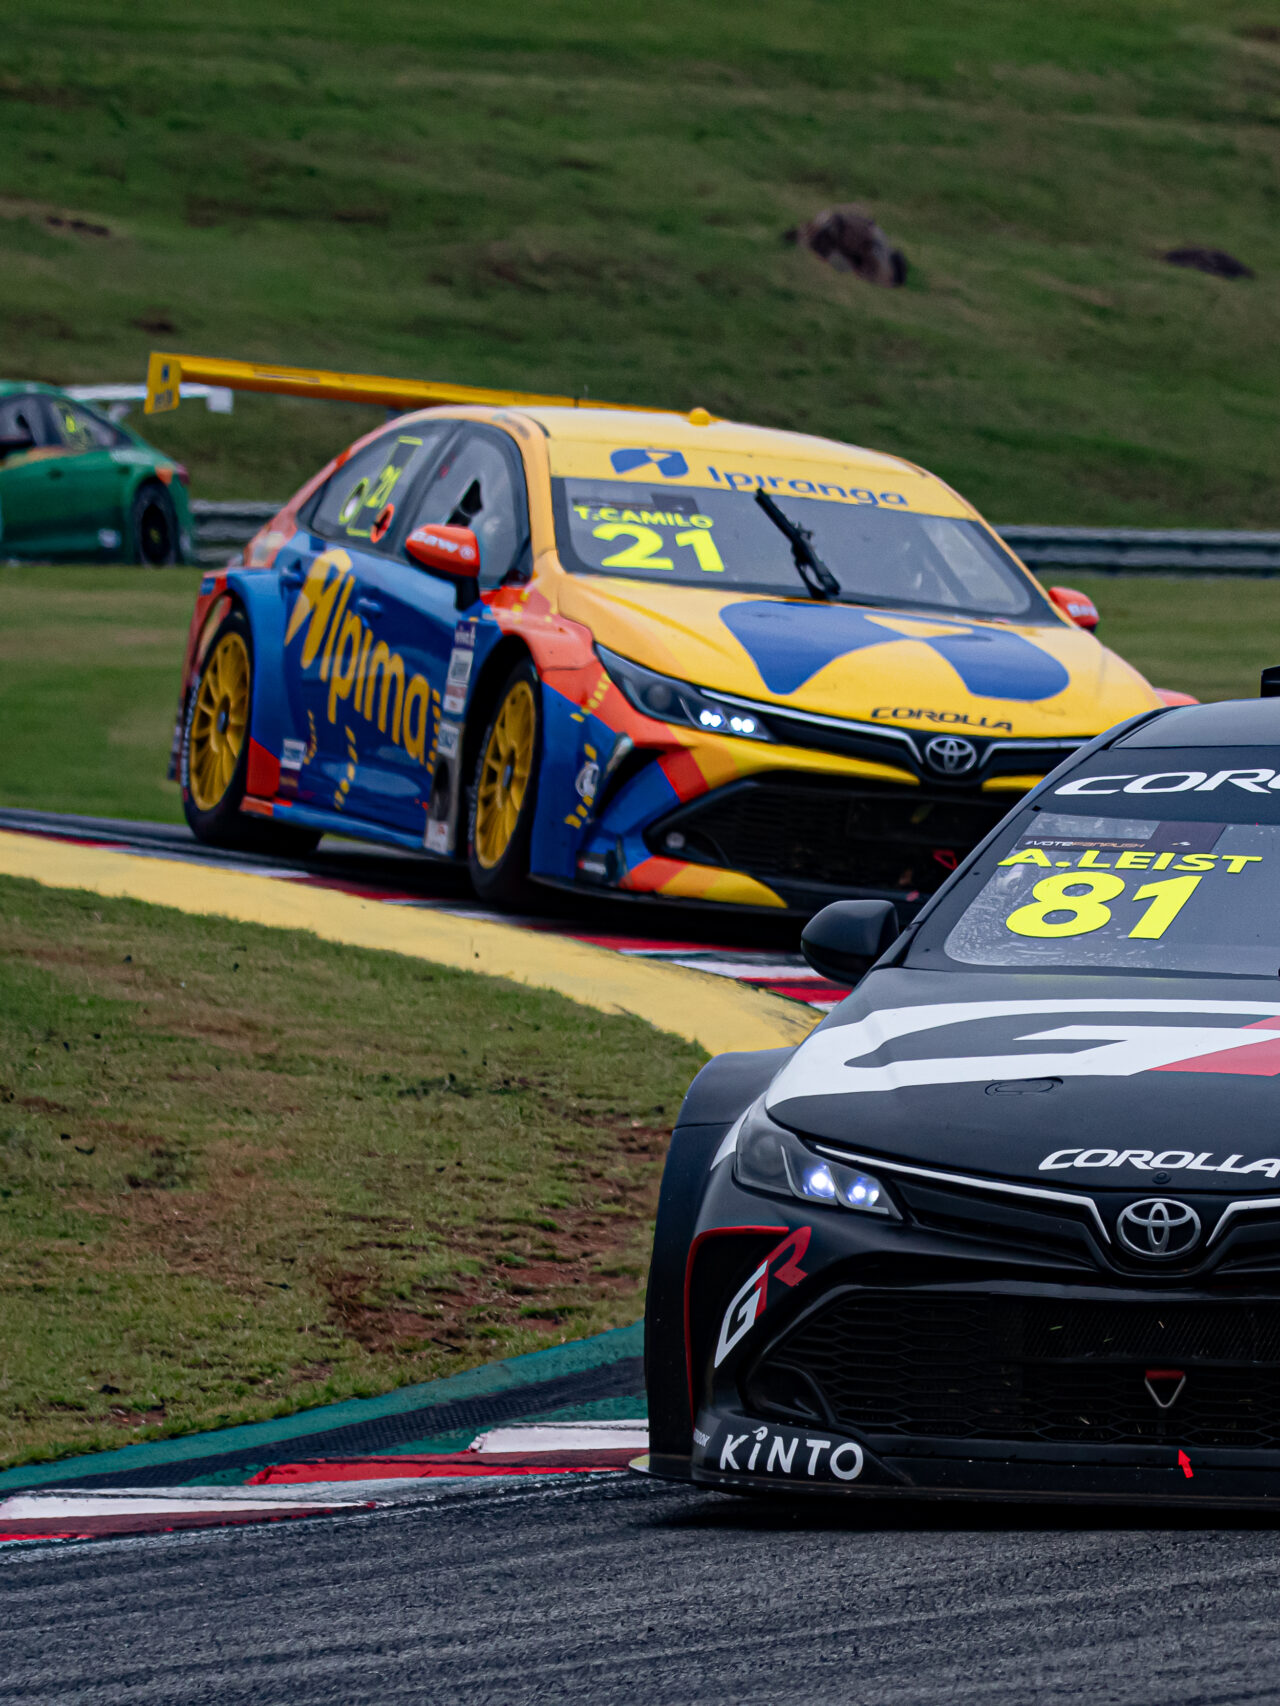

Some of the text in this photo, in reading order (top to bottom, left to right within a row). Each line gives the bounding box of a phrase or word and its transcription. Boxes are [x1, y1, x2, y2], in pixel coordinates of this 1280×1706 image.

[707, 465, 908, 507] Ipiranga
[573, 505, 714, 529] T.CAMILO
[592, 523, 725, 572] 21
[871, 706, 1012, 733] COROLLA
[998, 848, 1263, 873] A.LEIST
[1006, 871, 1202, 940] 81
[714, 1226, 812, 1369] GR
